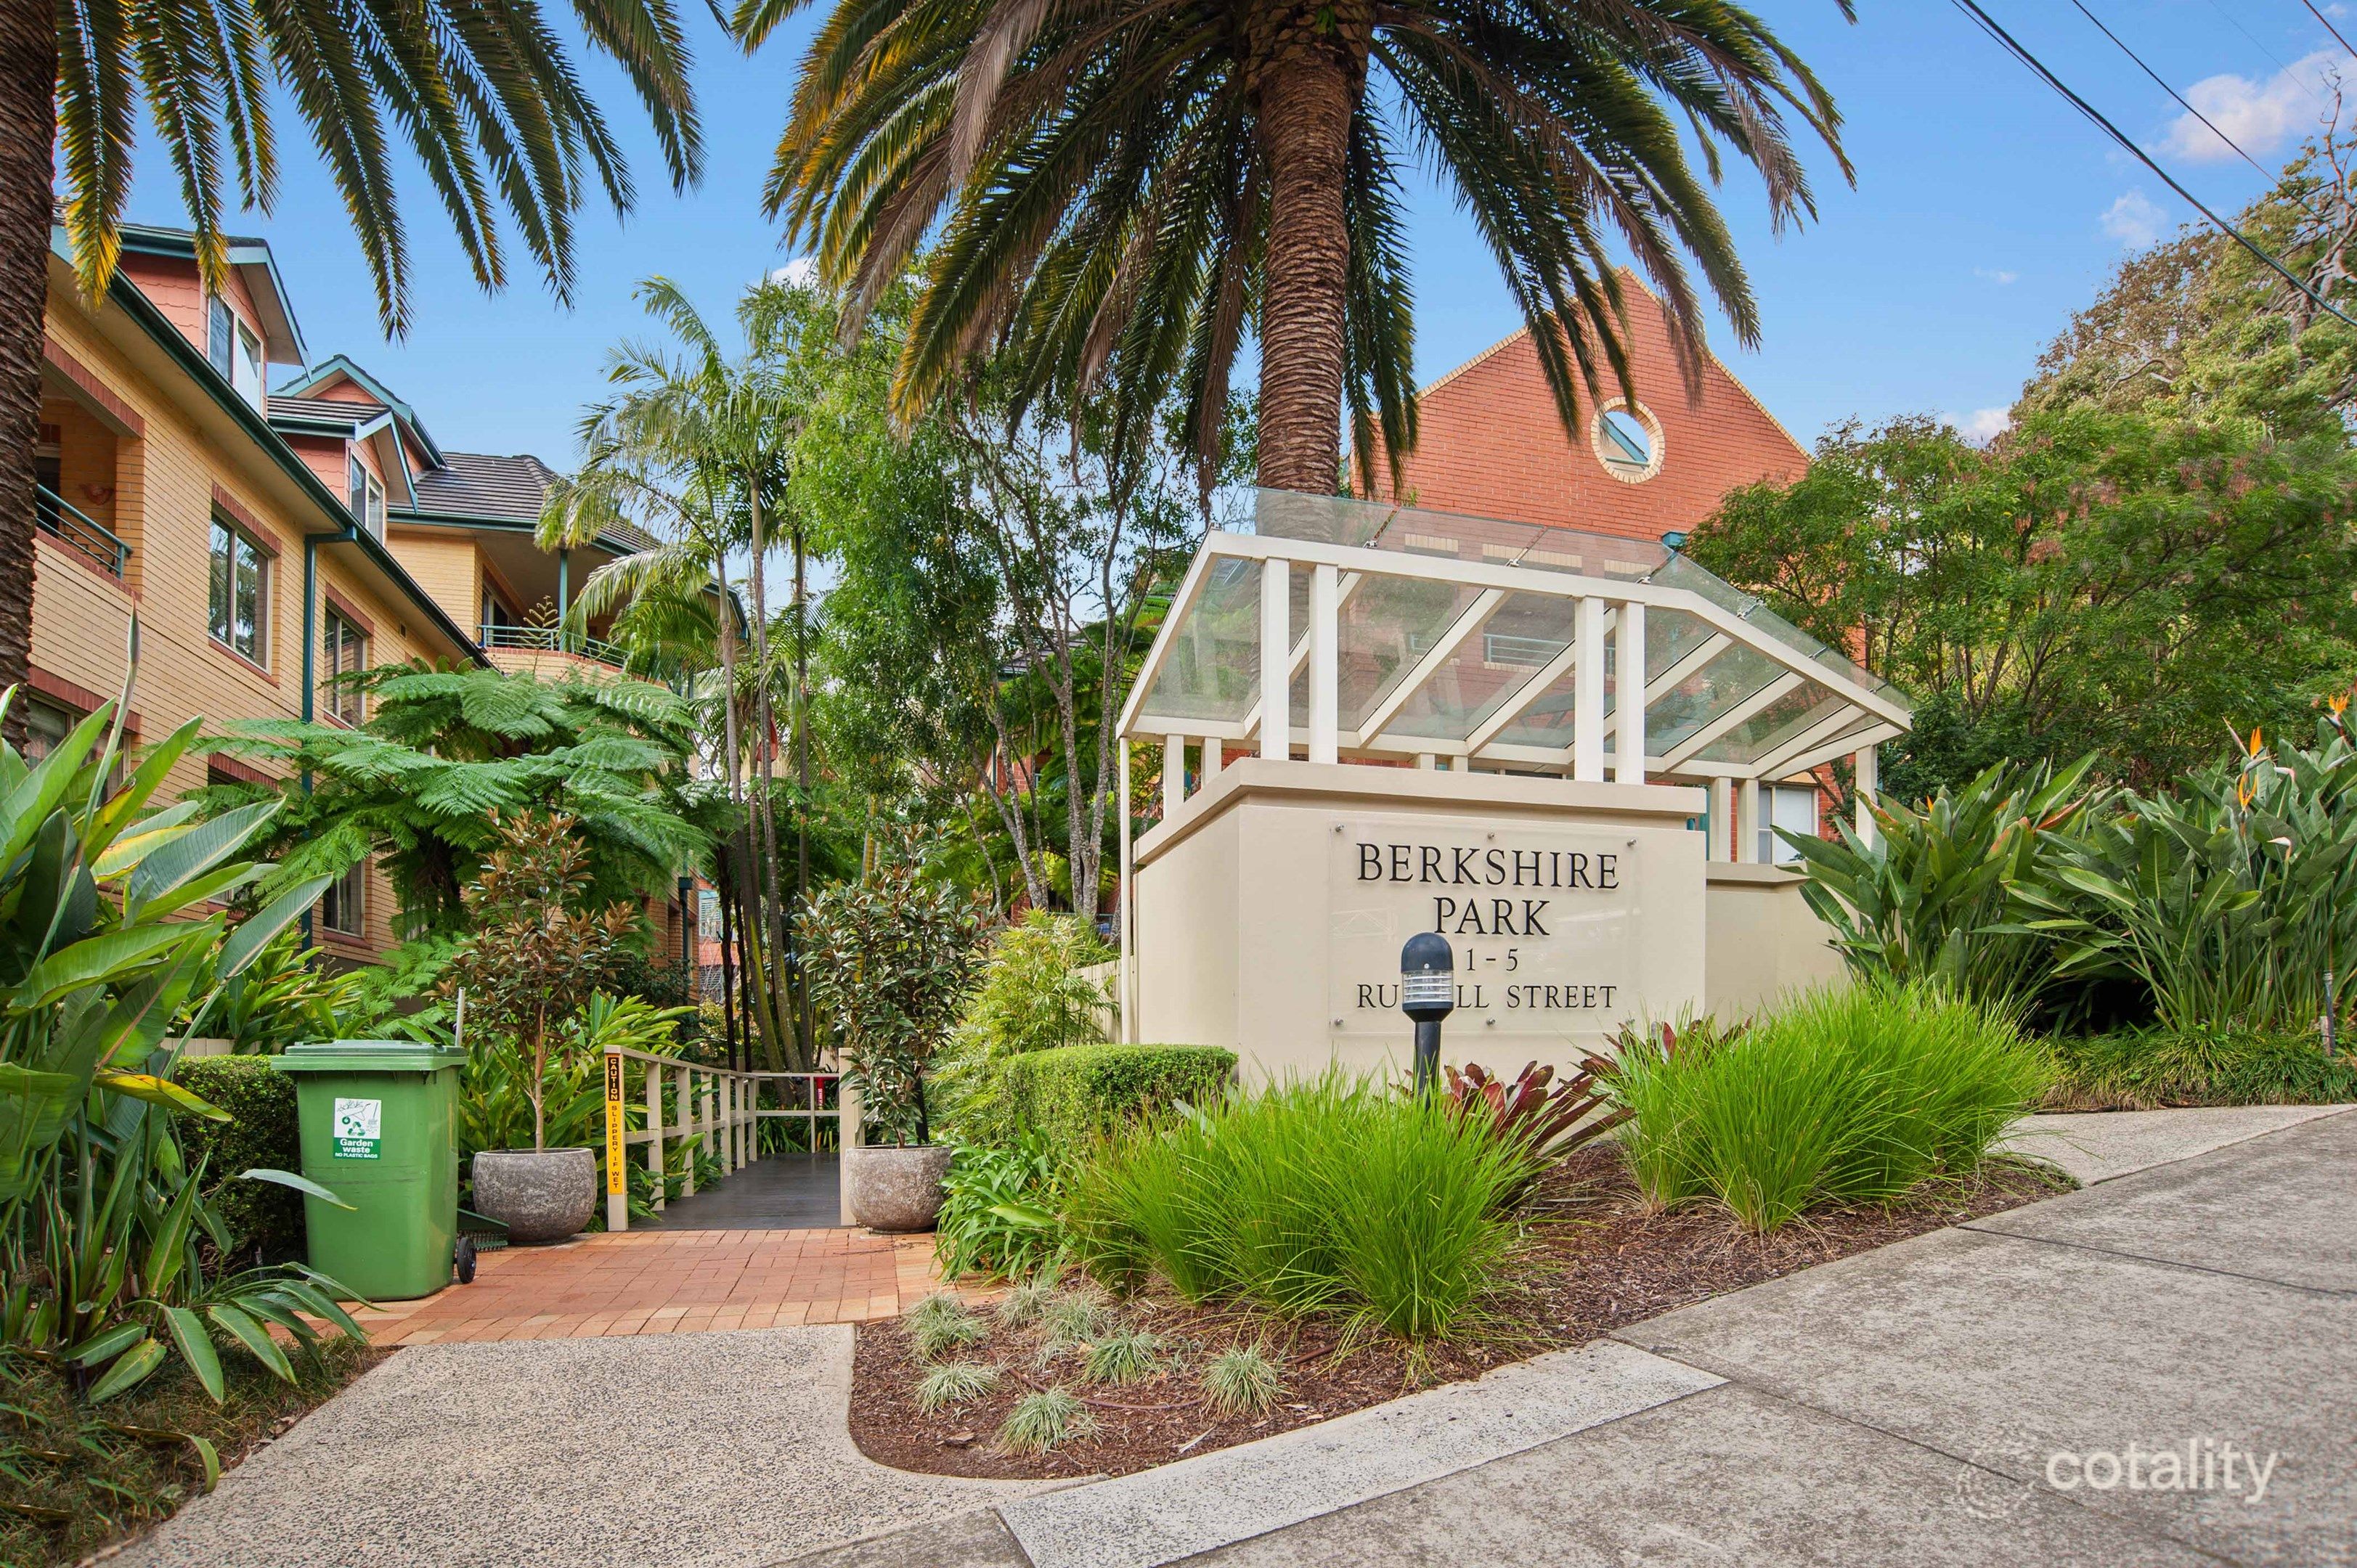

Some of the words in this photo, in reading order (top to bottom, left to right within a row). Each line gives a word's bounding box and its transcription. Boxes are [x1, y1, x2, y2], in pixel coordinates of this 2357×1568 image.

[1356, 842, 1620, 890] BERKSHIRE
[1433, 897, 1551, 936] PARK
[1356, 983, 1491, 1009] RULL
[1506, 984, 1618, 1009] STREET
[340, 1138, 373, 1147] Garden
[612, 1156, 619, 1167] IF
[611, 1171, 620, 1188] WET
